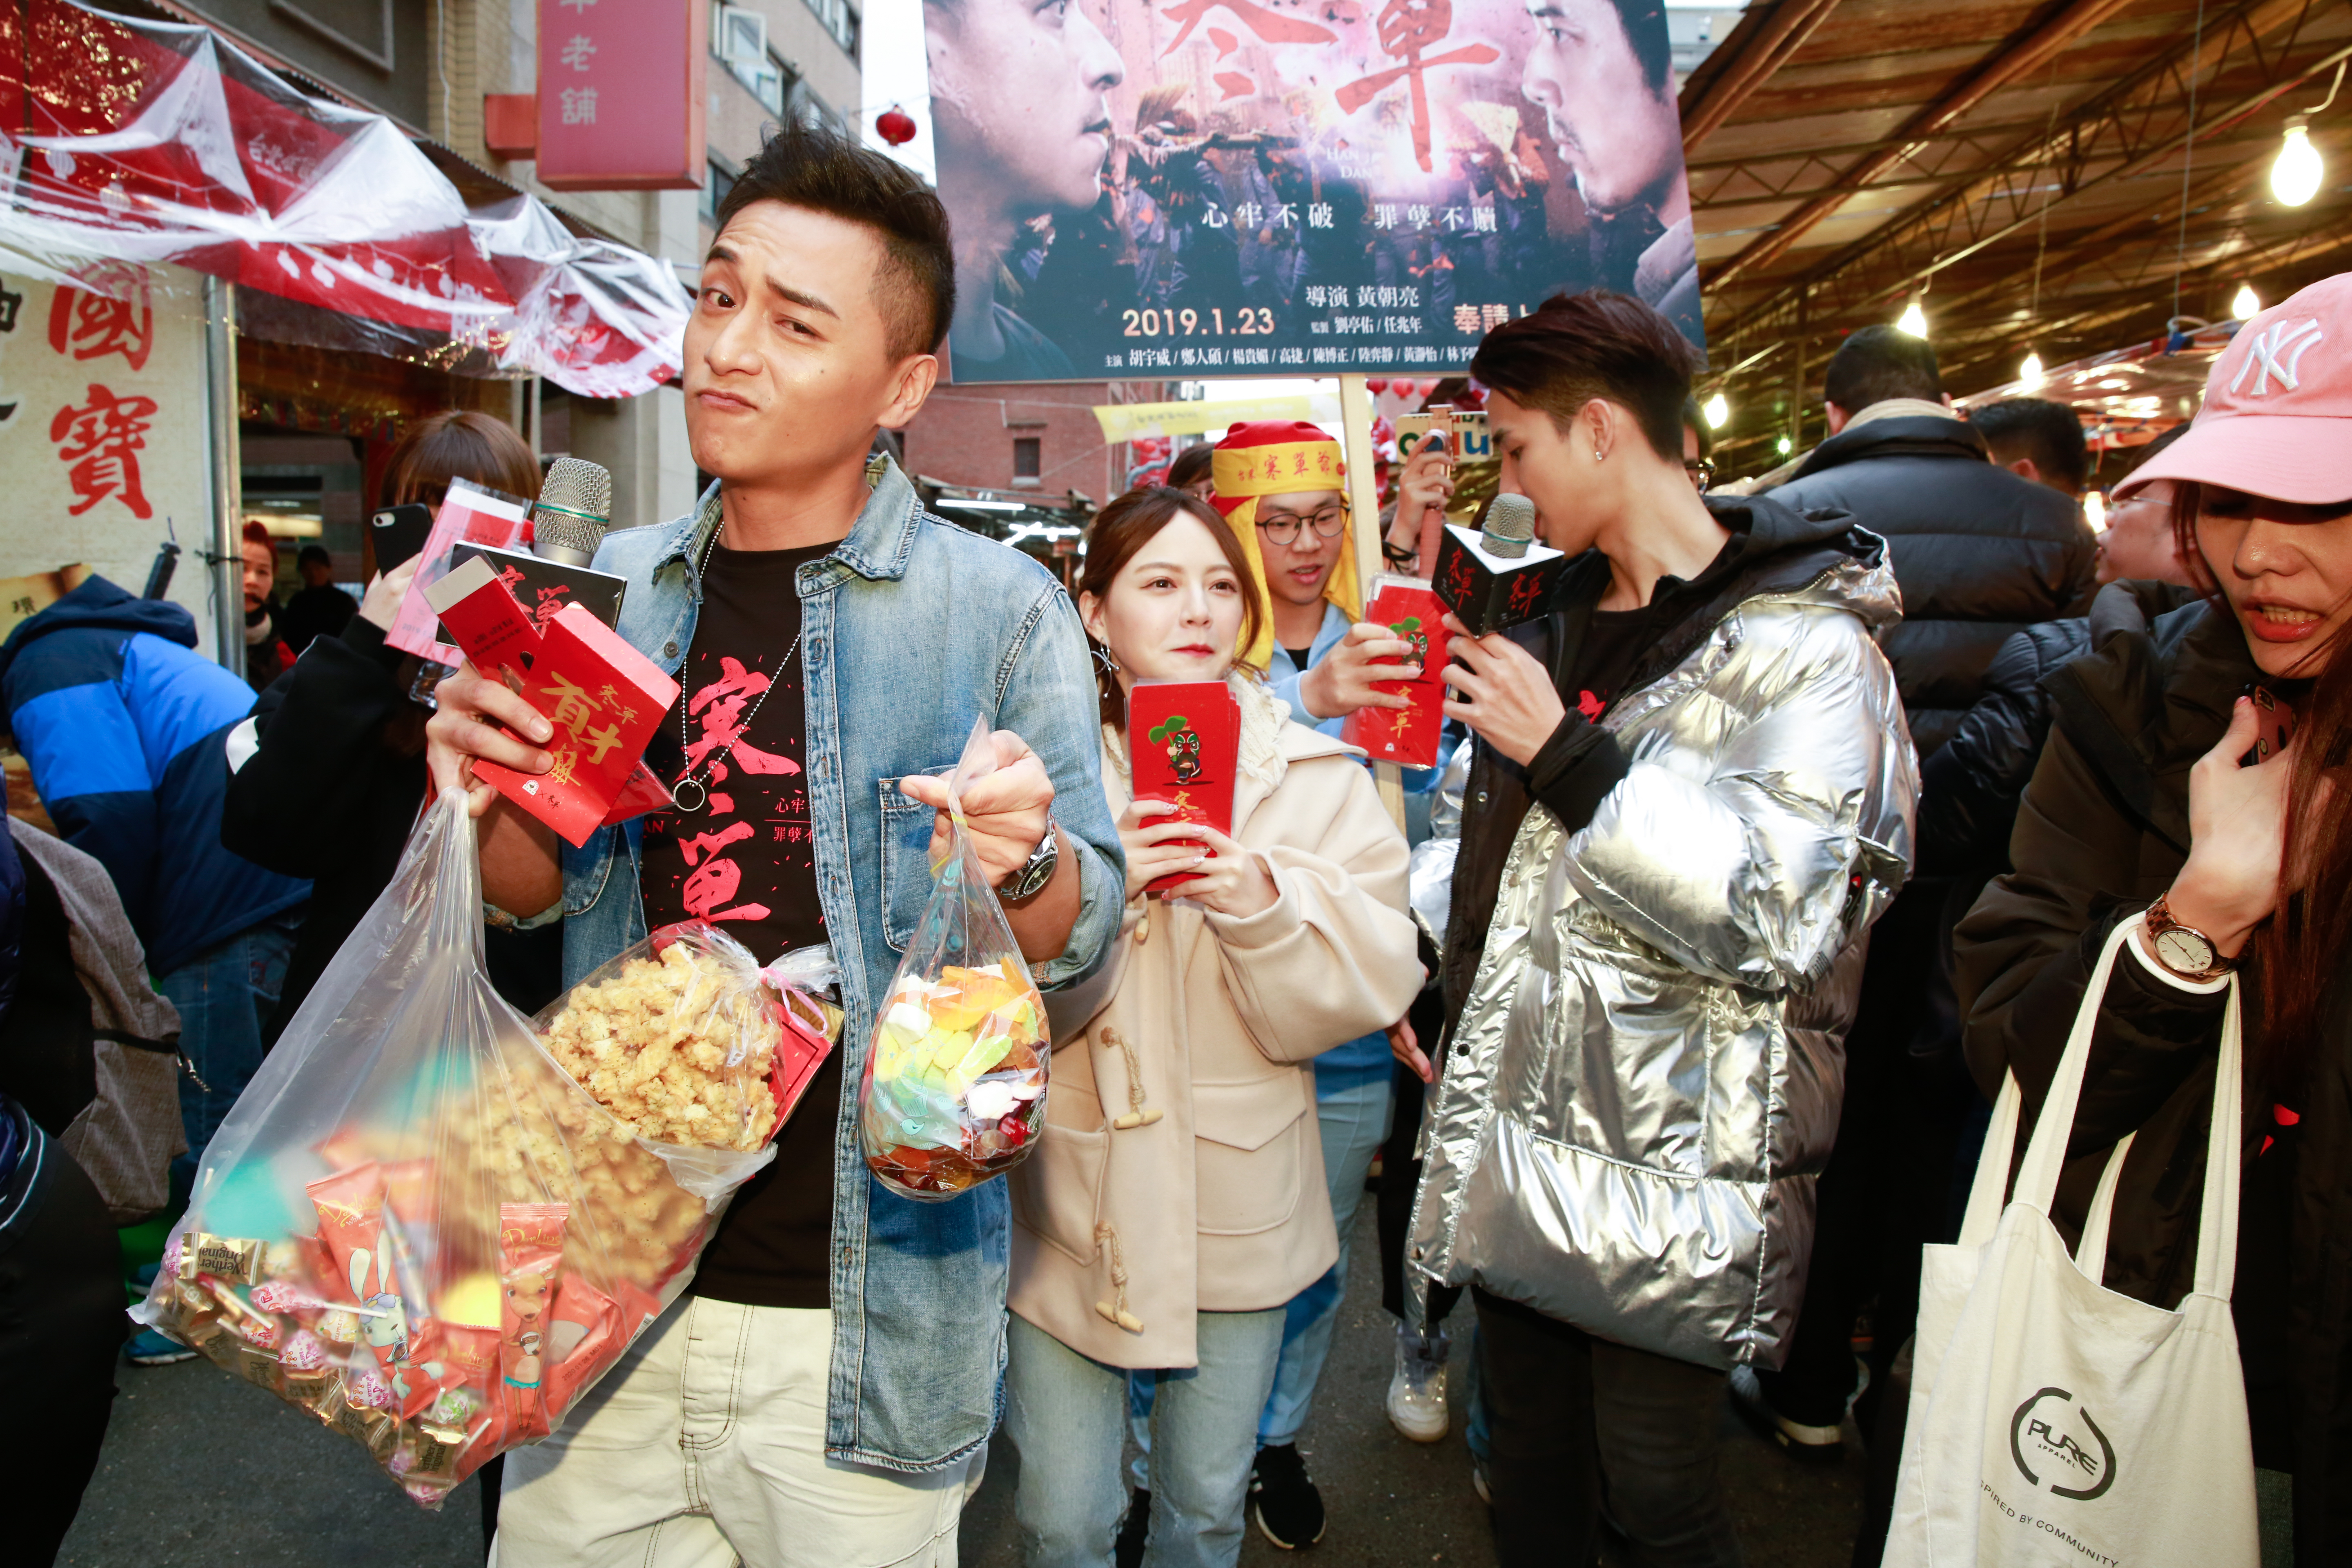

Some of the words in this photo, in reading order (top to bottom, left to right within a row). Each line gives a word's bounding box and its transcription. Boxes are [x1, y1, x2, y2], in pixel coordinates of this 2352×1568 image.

[1201, 202, 1334, 229] 心牢不破
[1306, 285, 1349, 308] 導演
[1356, 285, 1420, 308] 黃朝亮
[1122, 307, 1275, 336] 2019.1.23
[2230, 318, 2323, 395] NY
[775, 797, 810, 814] 心牢
[643, 820, 665, 834] AN
[2027, 1419, 2098, 1476] PURE
[2037, 1443, 2076, 1469] APPAREL
[2019, 1514, 2033, 1524] BY
[2036, 1520, 2118, 1568] COMMUNITY
